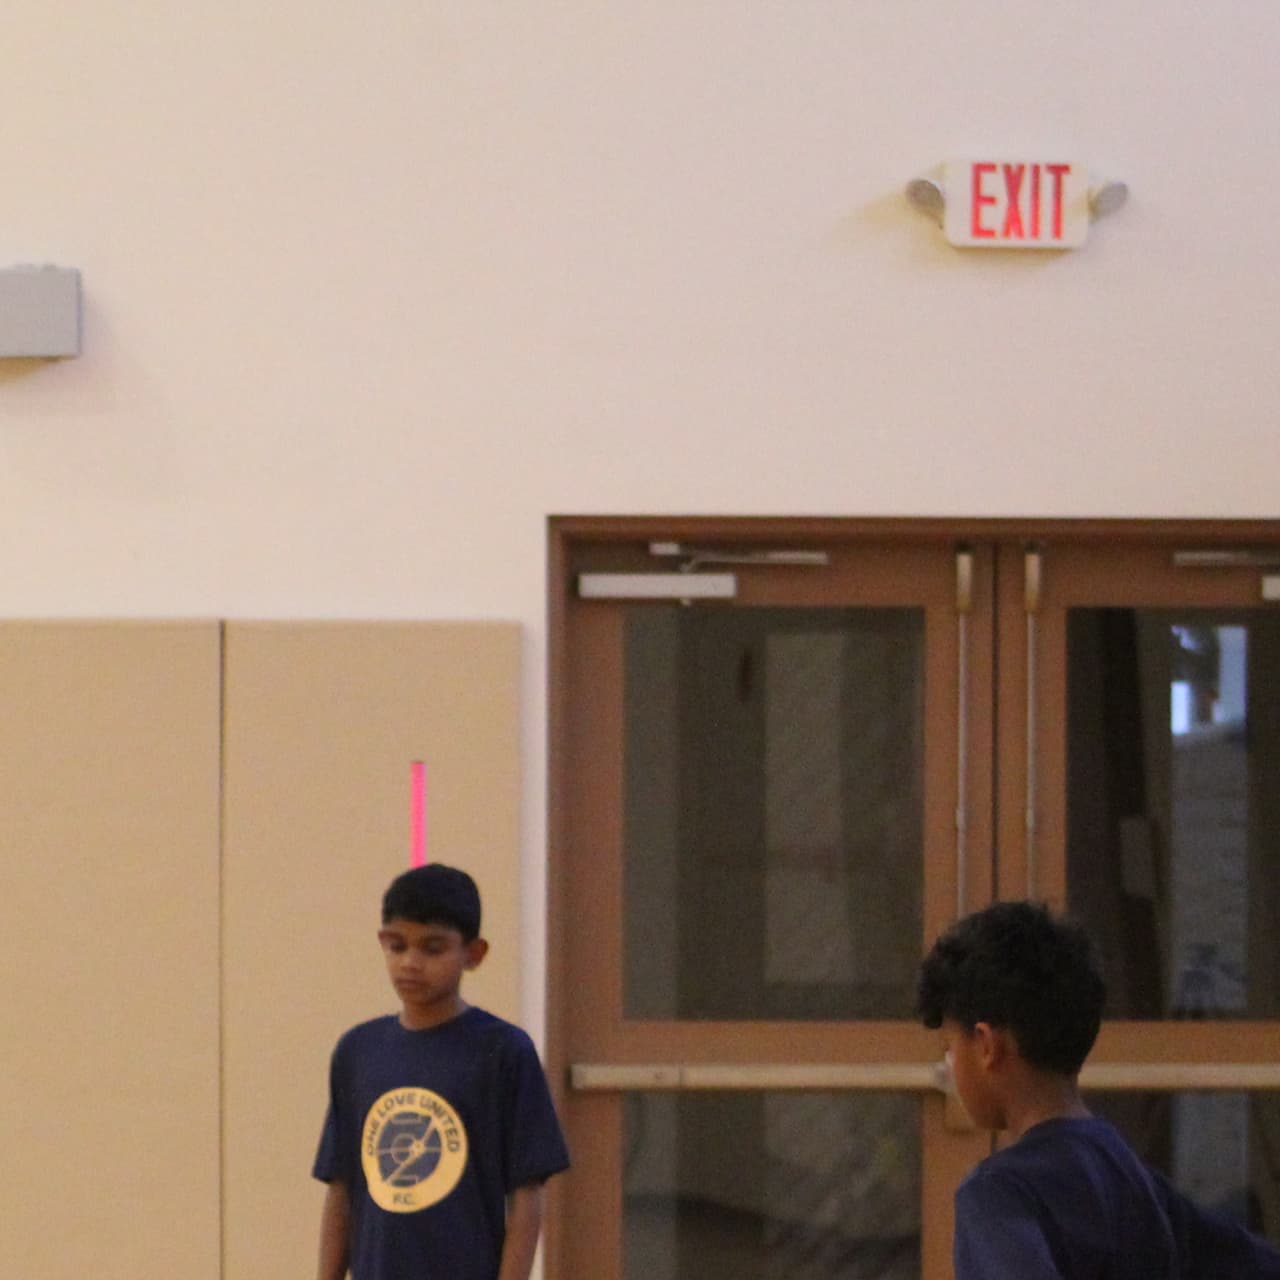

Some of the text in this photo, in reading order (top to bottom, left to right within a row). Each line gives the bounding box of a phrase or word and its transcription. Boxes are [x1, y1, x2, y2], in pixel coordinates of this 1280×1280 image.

[970, 162, 1072, 240] EXIT
[368, 1093, 460, 1157] ONE LOVE UNITED
